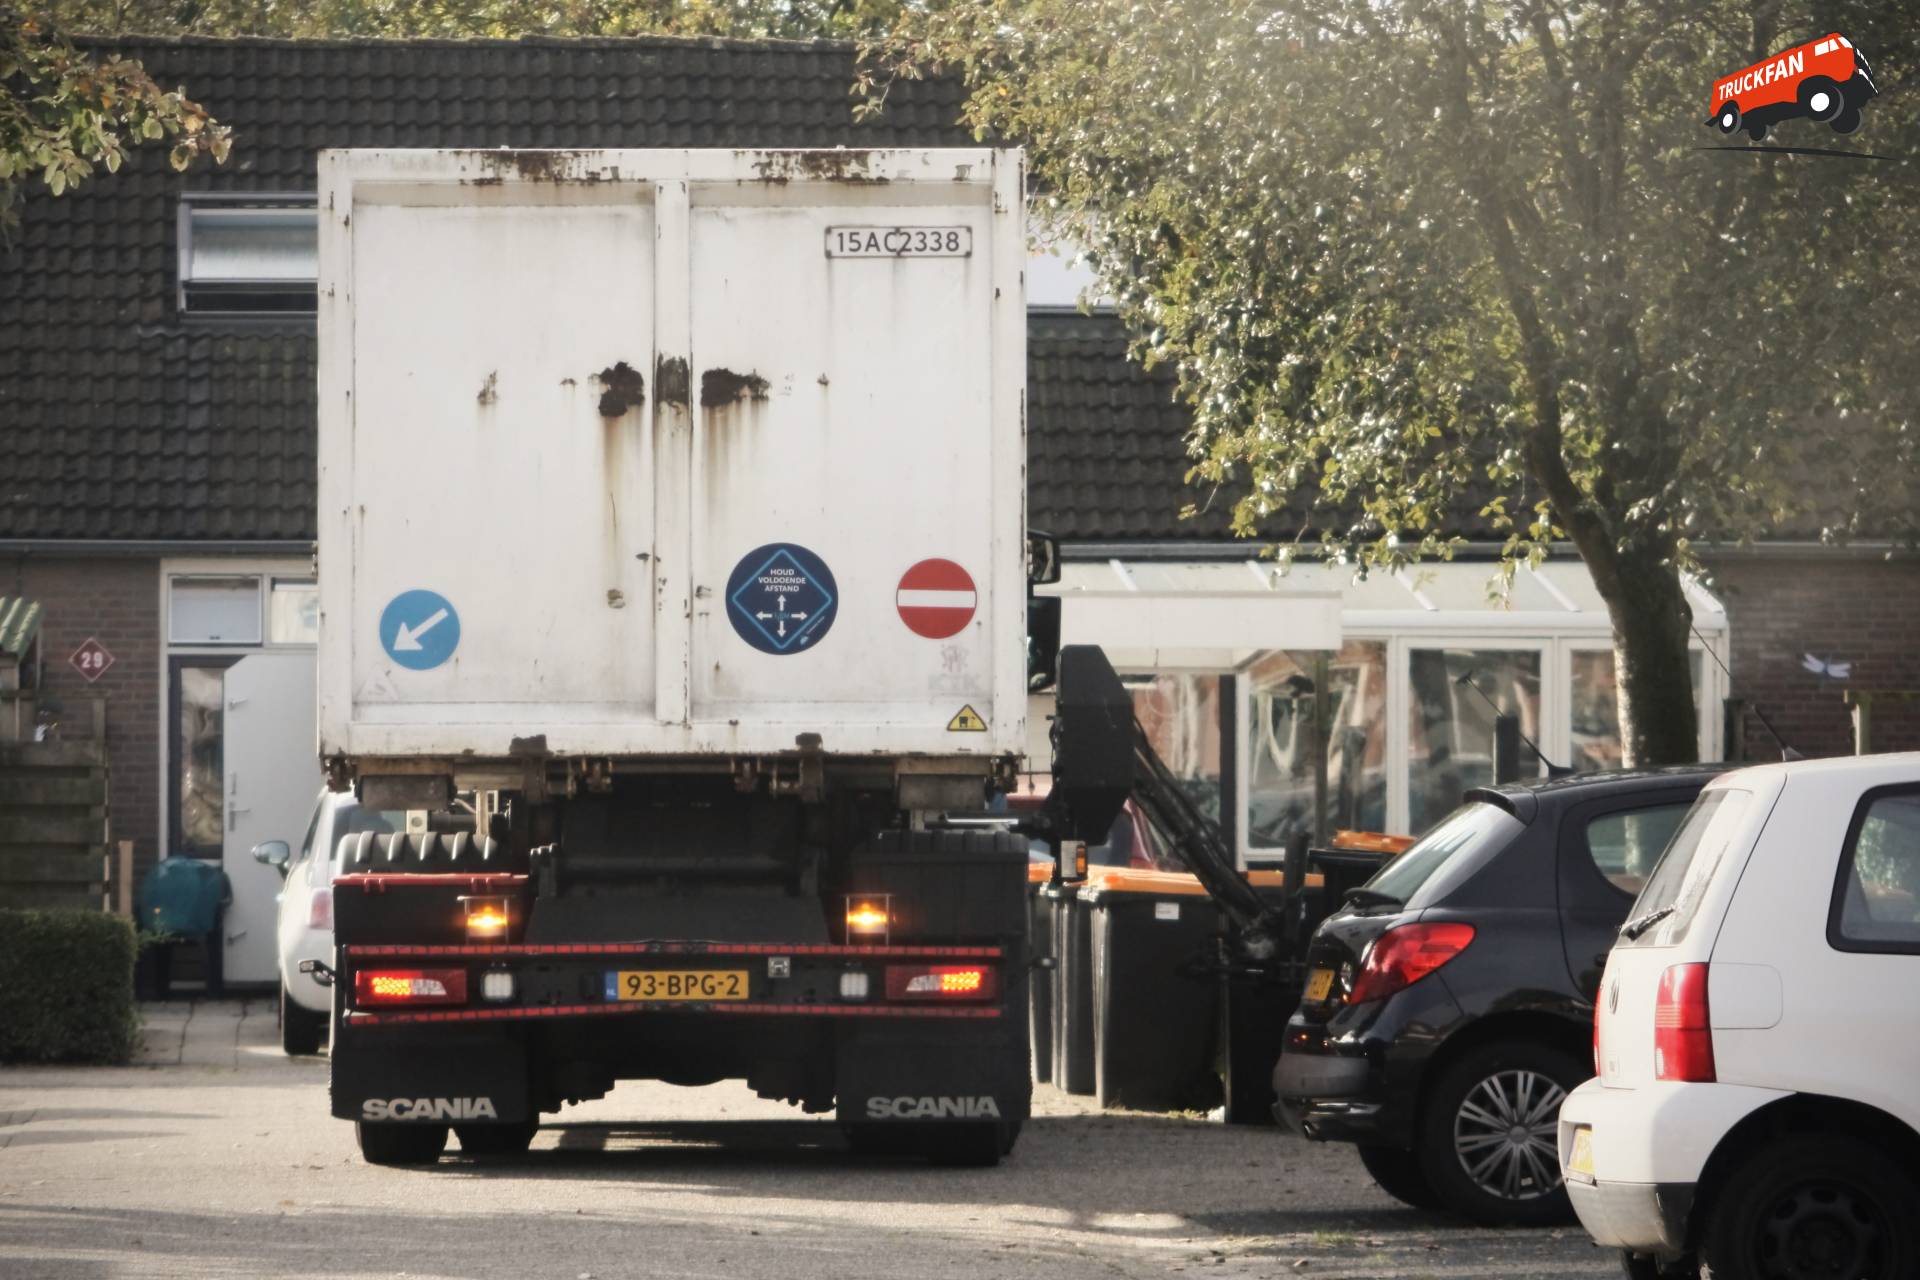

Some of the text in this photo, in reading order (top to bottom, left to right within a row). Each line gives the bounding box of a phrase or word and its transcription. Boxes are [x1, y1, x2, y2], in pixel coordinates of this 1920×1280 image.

[838, 232, 960, 252] 15AC2338
[758, 577, 806, 585] VOLDOENDE
[770, 568, 795, 576] HOUD
[764, 585, 800, 593] AFSTAND
[81, 652, 103, 668] 29
[627, 974, 740, 996] 93-BPG-2
[362, 1097, 498, 1121] SCANIA
[866, 1096, 1001, 1119] SCANIA
